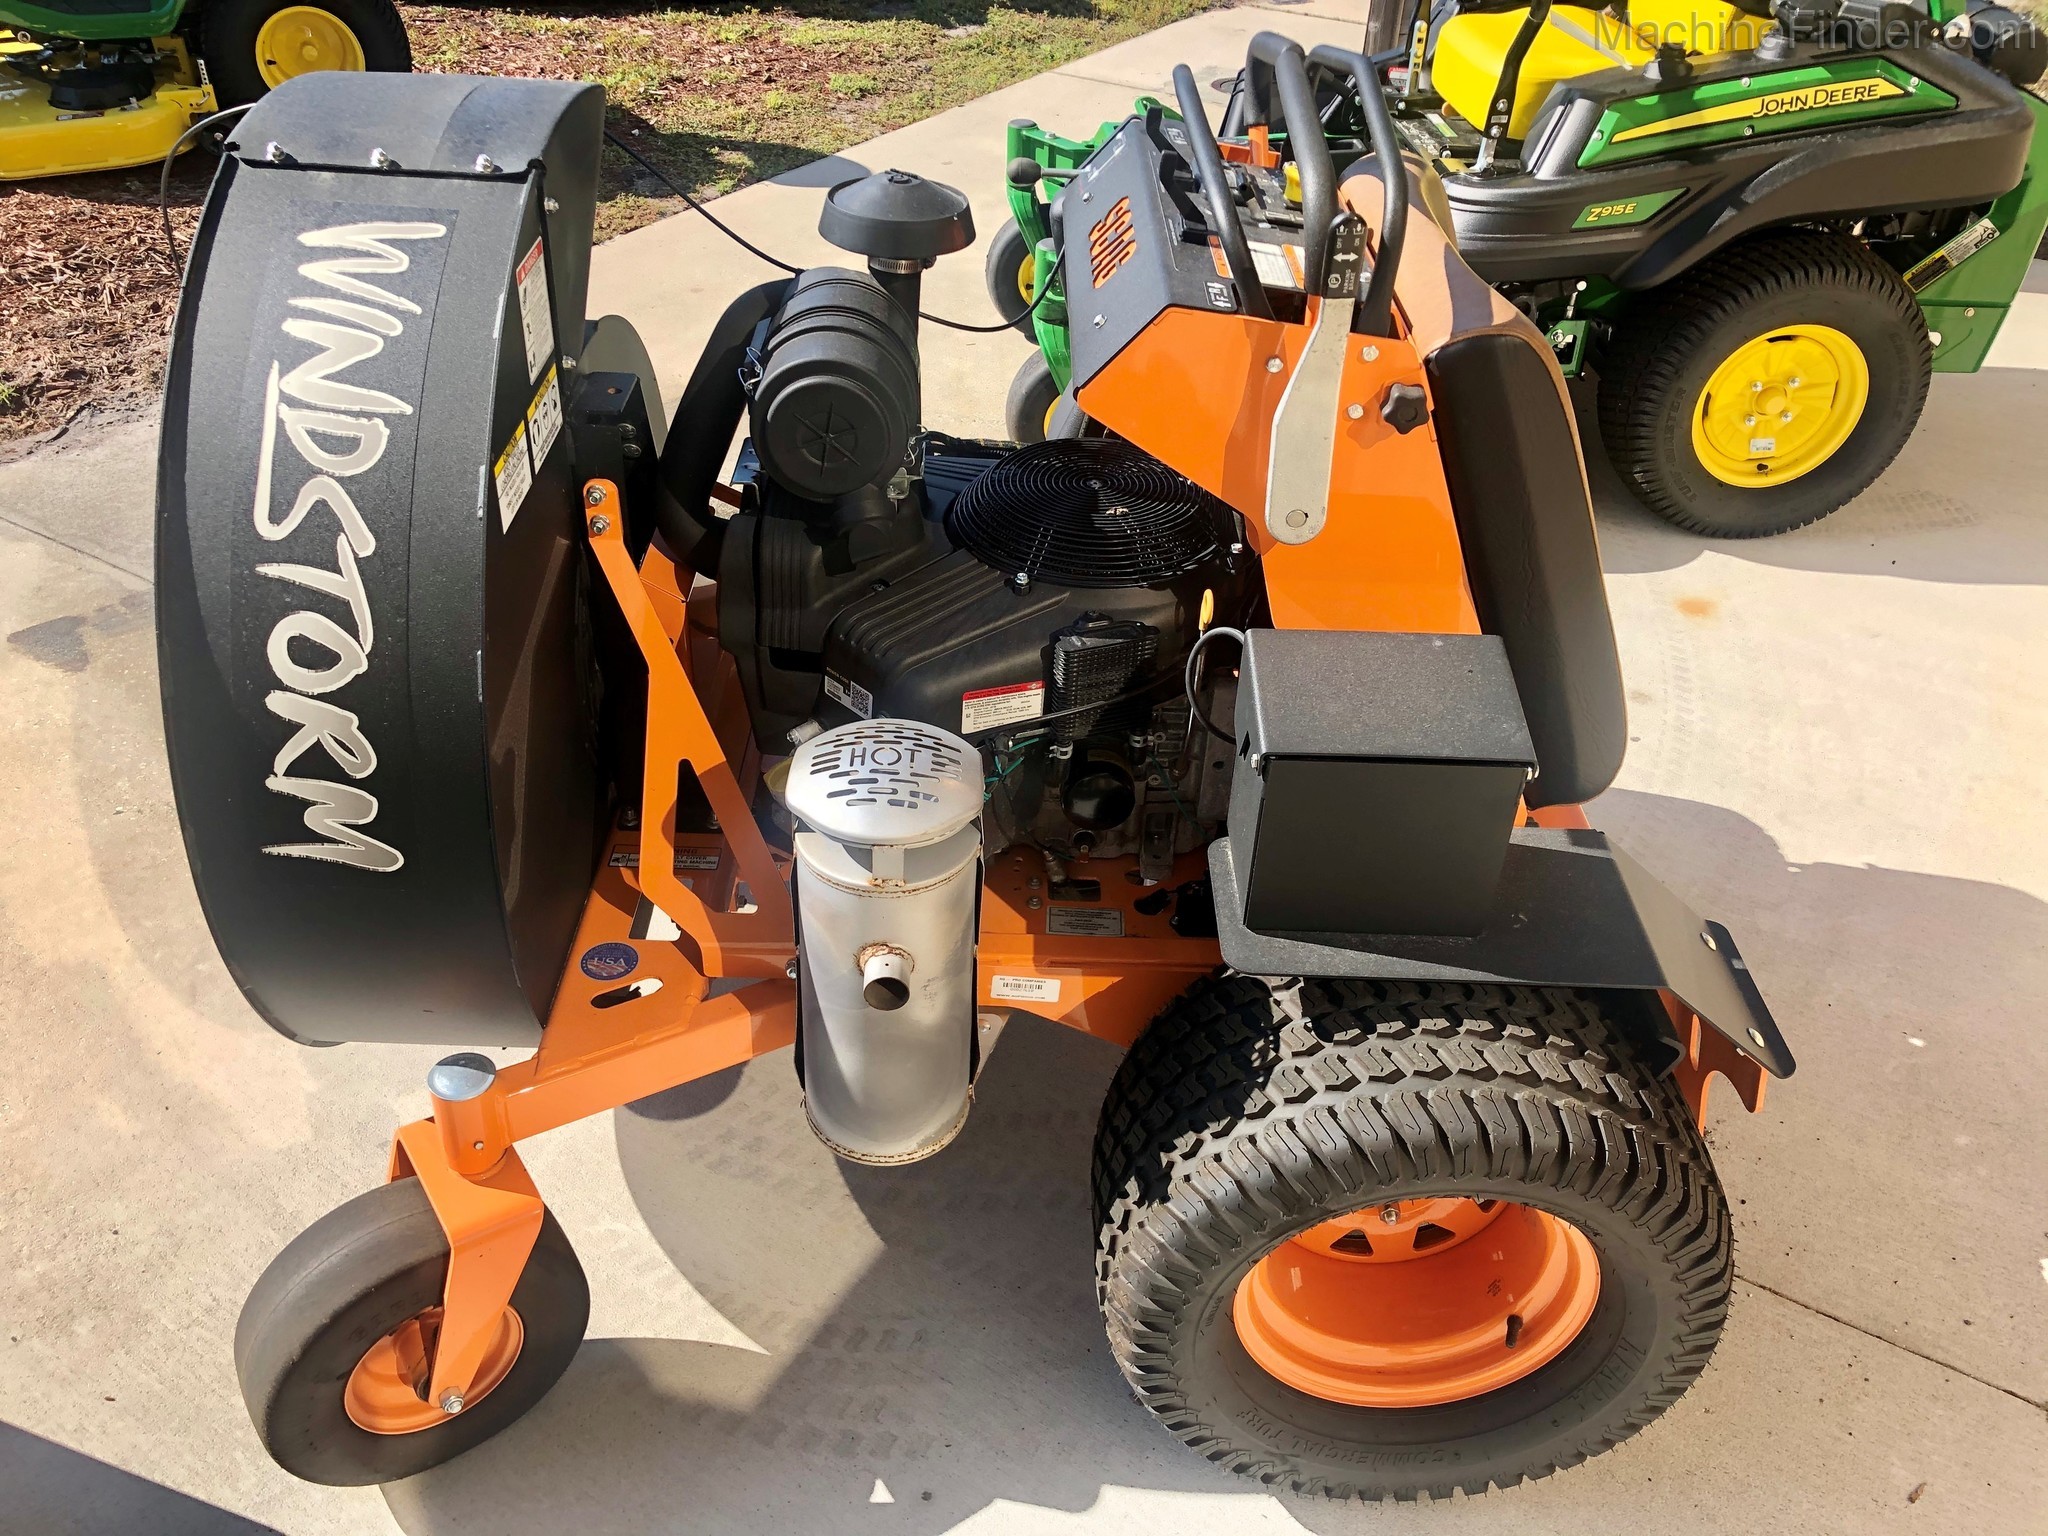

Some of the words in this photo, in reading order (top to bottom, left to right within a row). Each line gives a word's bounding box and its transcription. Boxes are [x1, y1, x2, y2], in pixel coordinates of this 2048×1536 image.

[1753, 94, 1809, 116] JOHN
[1813, 84, 1880, 105] DEERE
[1586, 203, 1637, 221] Z915E
[1087, 195, 1137, 289] SCAG
[1354, 237, 1360, 247] ON
[1342, 268, 1351, 294] PARKING
[1348, 272, 1356, 291] BRAKE
[253, 222, 448, 872] WINDSTORM
[850, 746, 922, 768] HOT
[594, 957, 628, 969] USA
[1235, 1408, 1284, 1440] TURF
[1292, 1435, 1445, 1465] COMMERCIAL
